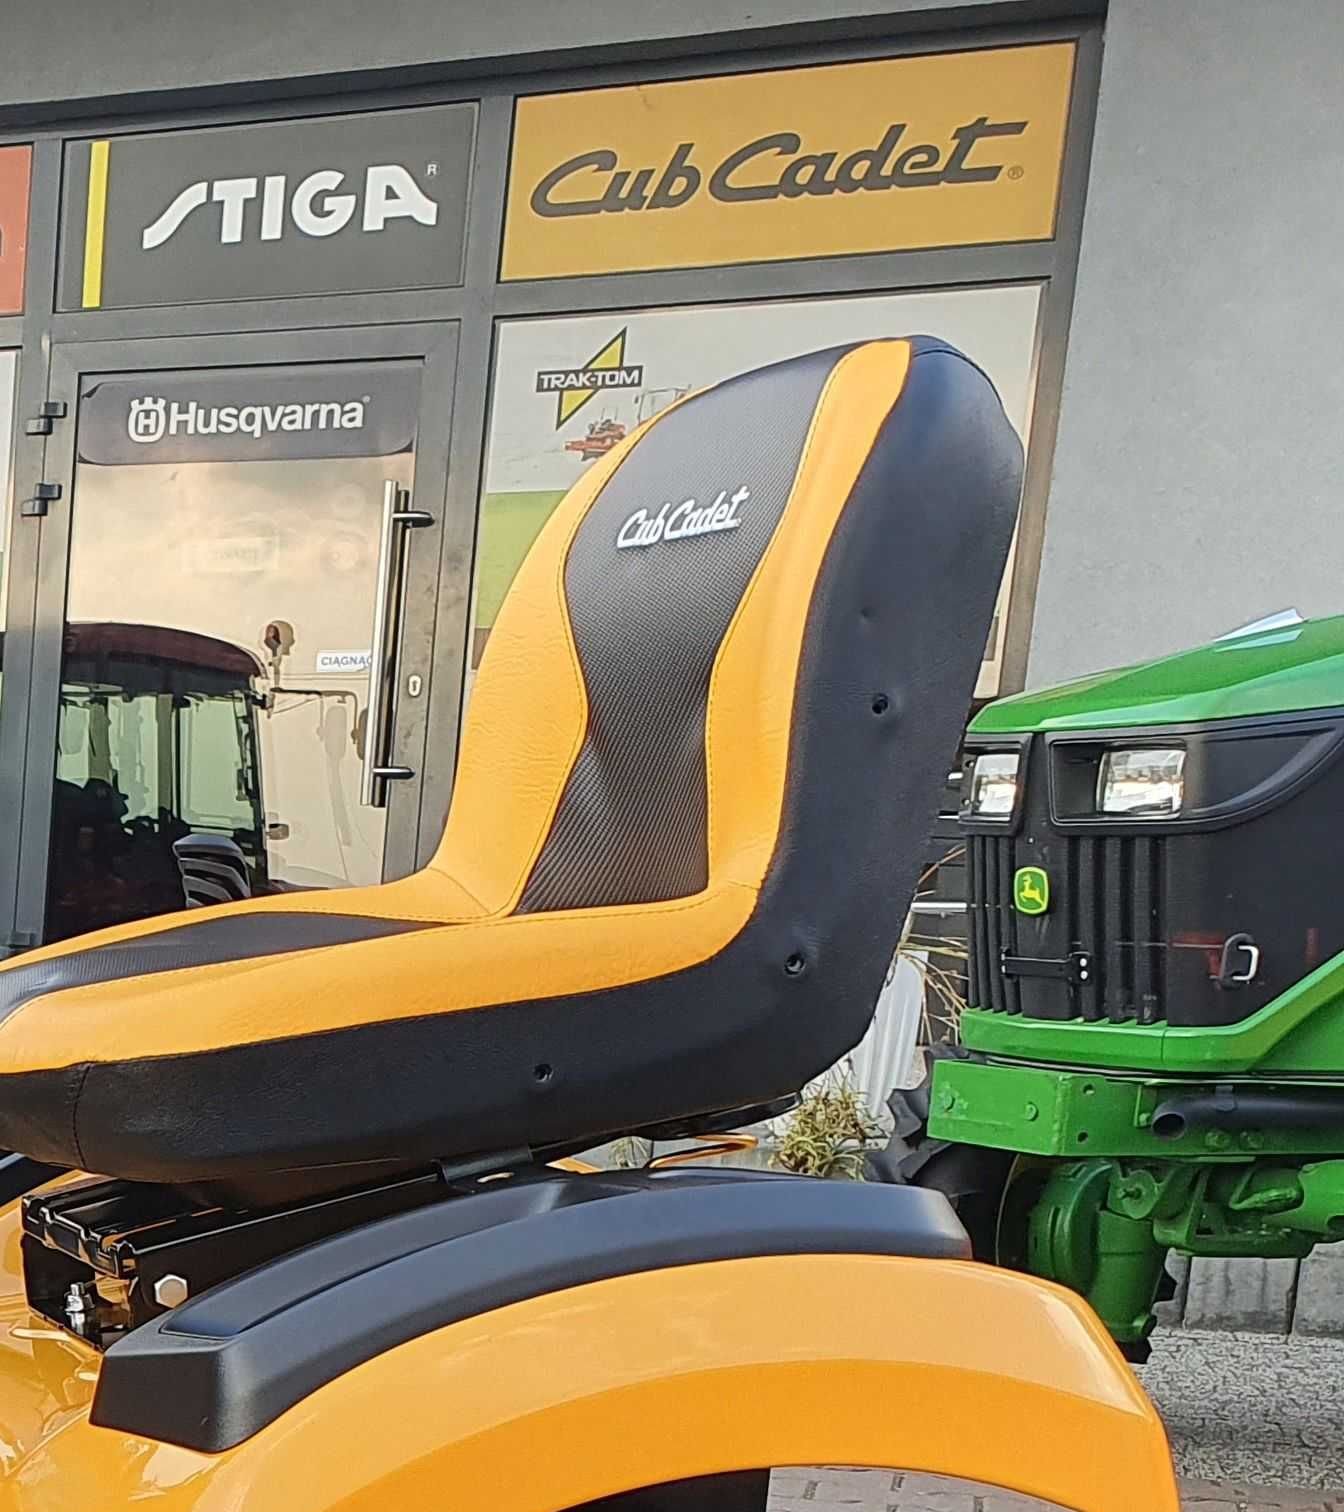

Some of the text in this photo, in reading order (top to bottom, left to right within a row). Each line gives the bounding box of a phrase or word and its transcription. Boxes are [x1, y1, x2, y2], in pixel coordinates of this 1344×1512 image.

[531, 118, 1028, 217] Cub Cadet
[142, 165, 438, 249] STIGA
[539, 369, 640, 389] TRAK-TOM
[169, 401, 362, 438] Husqvarna
[617, 486, 750, 548] Cub Cadet
